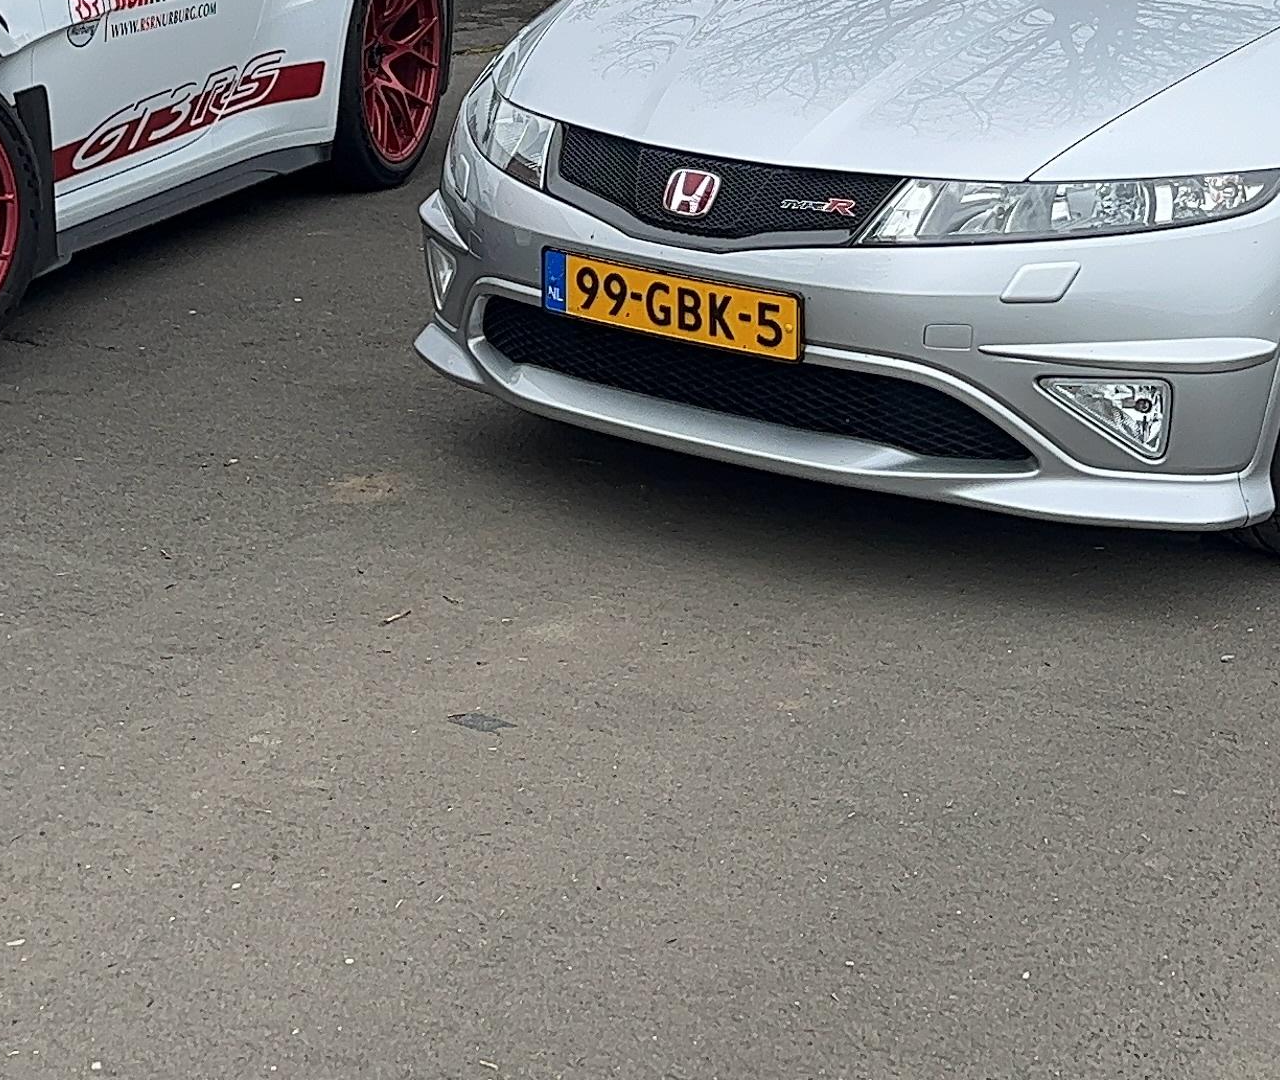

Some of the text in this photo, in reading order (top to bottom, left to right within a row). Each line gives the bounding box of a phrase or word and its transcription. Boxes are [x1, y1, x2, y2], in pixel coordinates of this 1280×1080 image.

[110, 1, 218, 38] WWW.RSRNURBURG.COM
[548, 285, 564, 302] NL
[575, 266, 784, 348] 99-GBK-5
